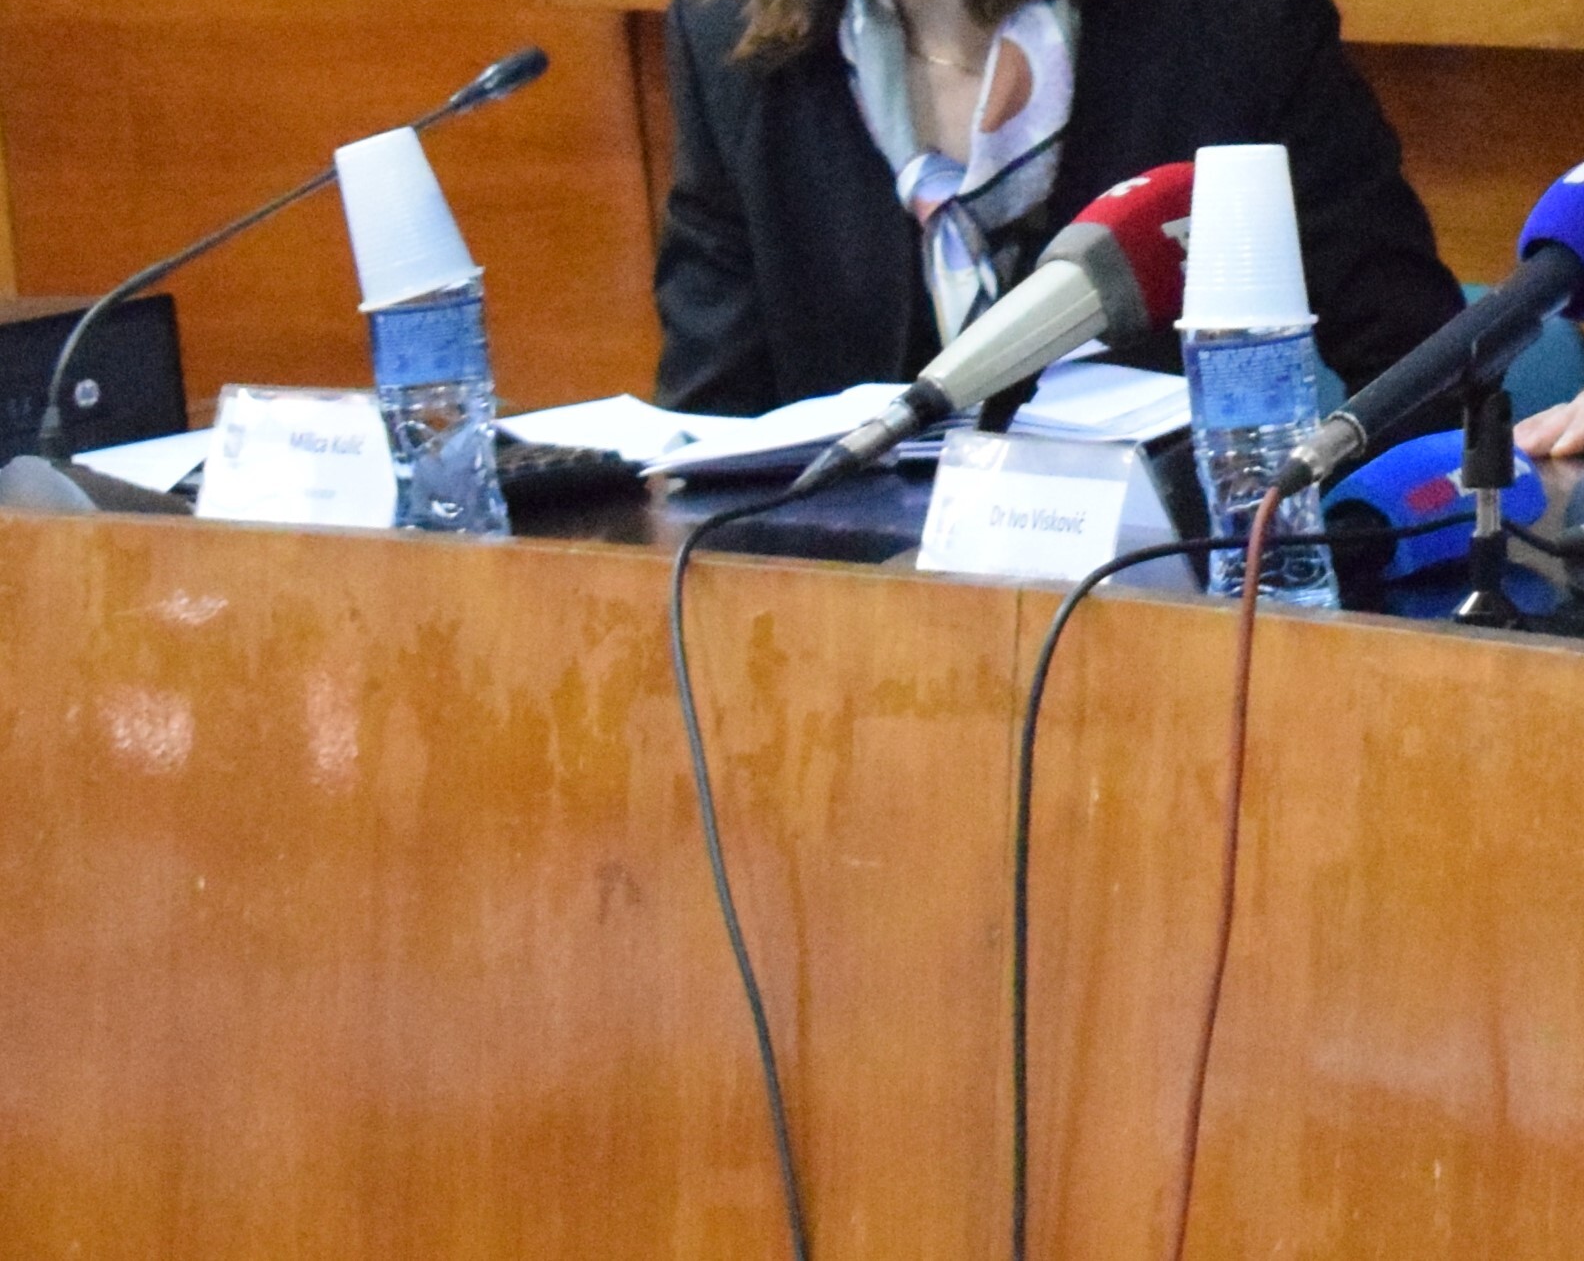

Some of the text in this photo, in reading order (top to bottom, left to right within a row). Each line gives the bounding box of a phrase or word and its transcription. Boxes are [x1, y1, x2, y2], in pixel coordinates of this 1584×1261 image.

[989, 504, 1087, 535] Dr Ivo Visković
